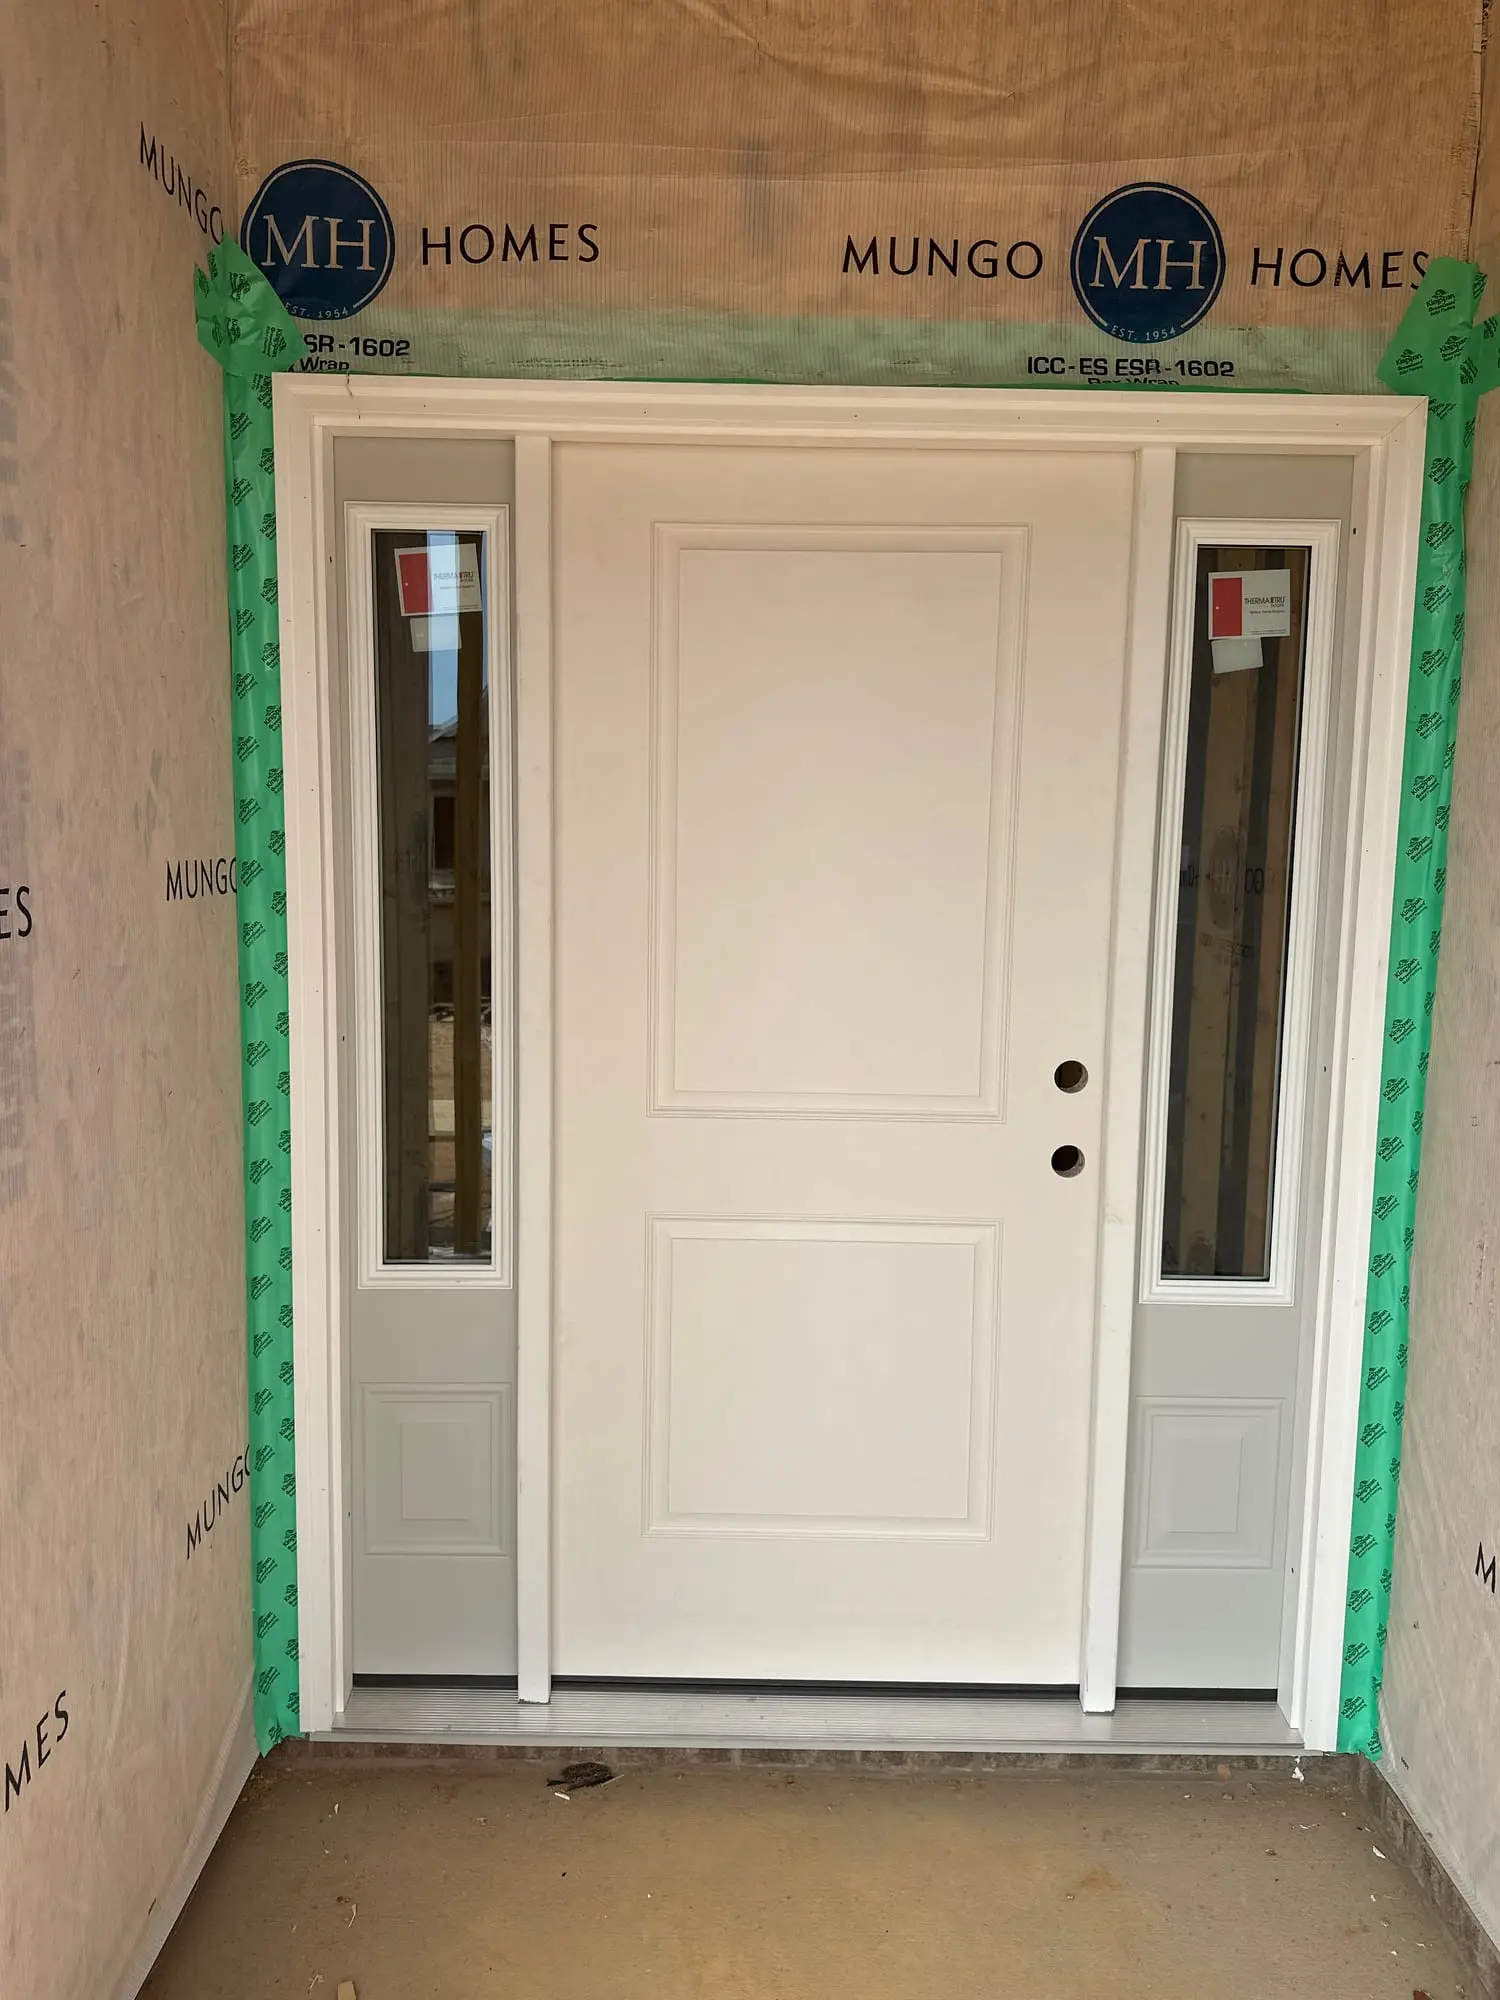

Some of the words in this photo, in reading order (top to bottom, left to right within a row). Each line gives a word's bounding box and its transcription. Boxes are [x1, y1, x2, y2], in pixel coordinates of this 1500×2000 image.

[140, 121, 224, 246] MUNGO
[261, 214, 376, 271] MH
[421, 223, 600, 266] HOMES
[842, 235, 1044, 280] MUNGO
[1089, 236, 1207, 290] MH
[1251, 247, 1429, 290] HOMES
[318, 306, 349, 319] 1954
[1111, 325, 1137, 340] EST.
[1146, 327, 1176, 341] 1954
[1028, 356, 1108, 376] ICC-ES
[1115, 358, 1235, 377] ESR-1602
